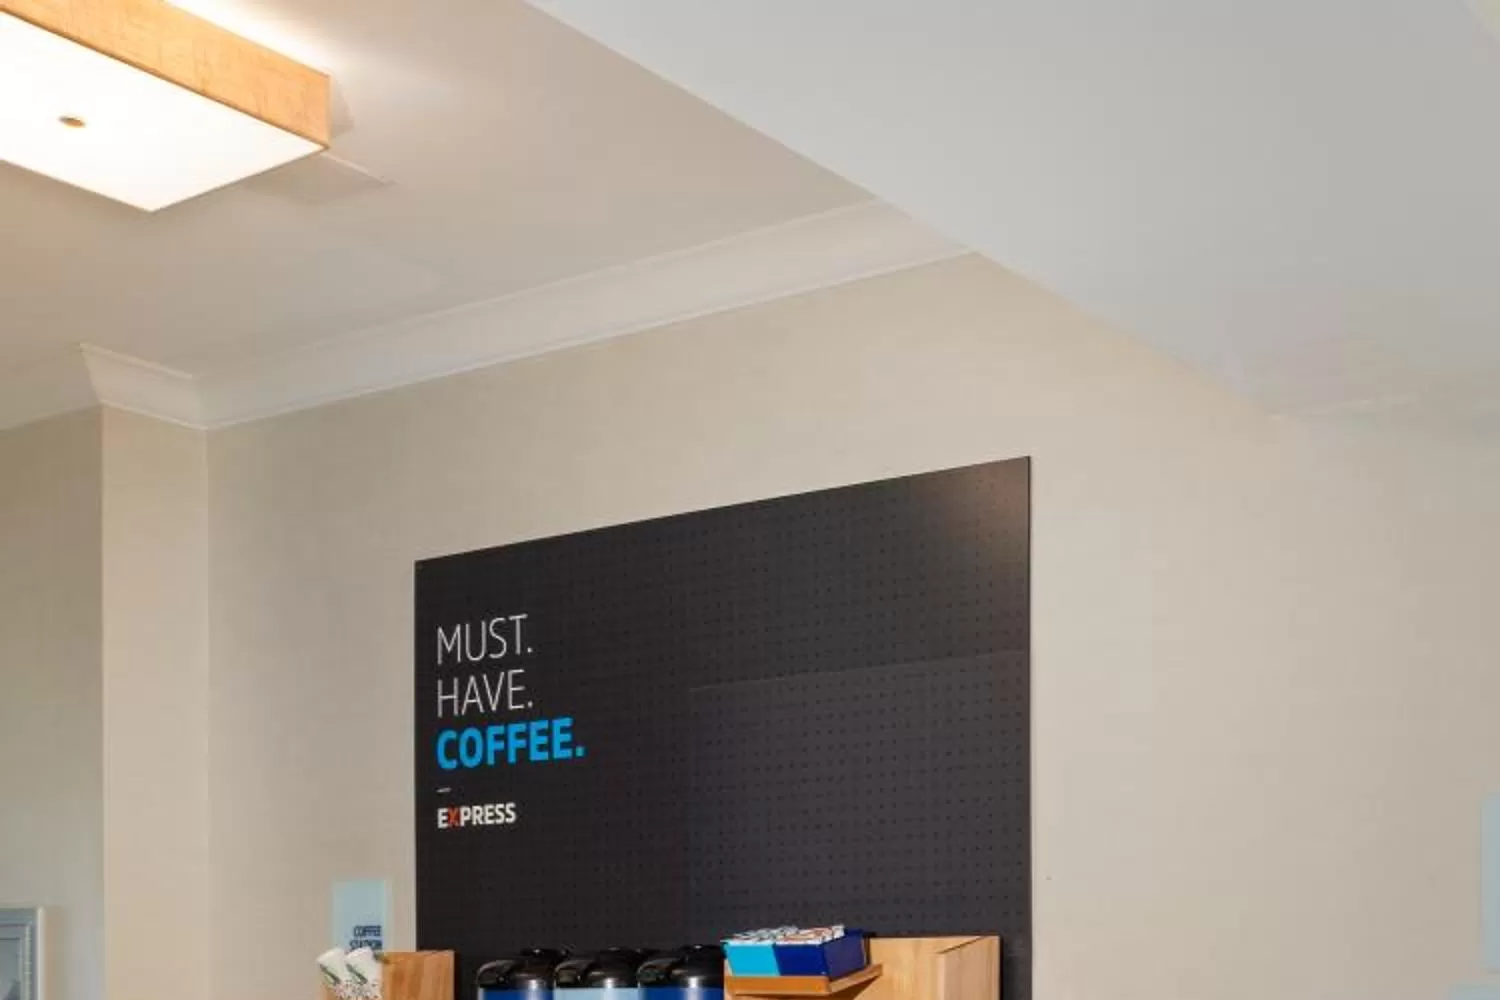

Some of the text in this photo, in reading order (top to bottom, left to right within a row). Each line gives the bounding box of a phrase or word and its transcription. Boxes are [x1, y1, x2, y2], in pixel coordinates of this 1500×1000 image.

[436, 612, 533, 666] MUST.
[436, 668, 533, 718] HAVE.
[436, 717, 587, 771] COFFEE.
[436, 802, 517, 829] EXPRESS
[353, 925, 382, 937] COFFEE
